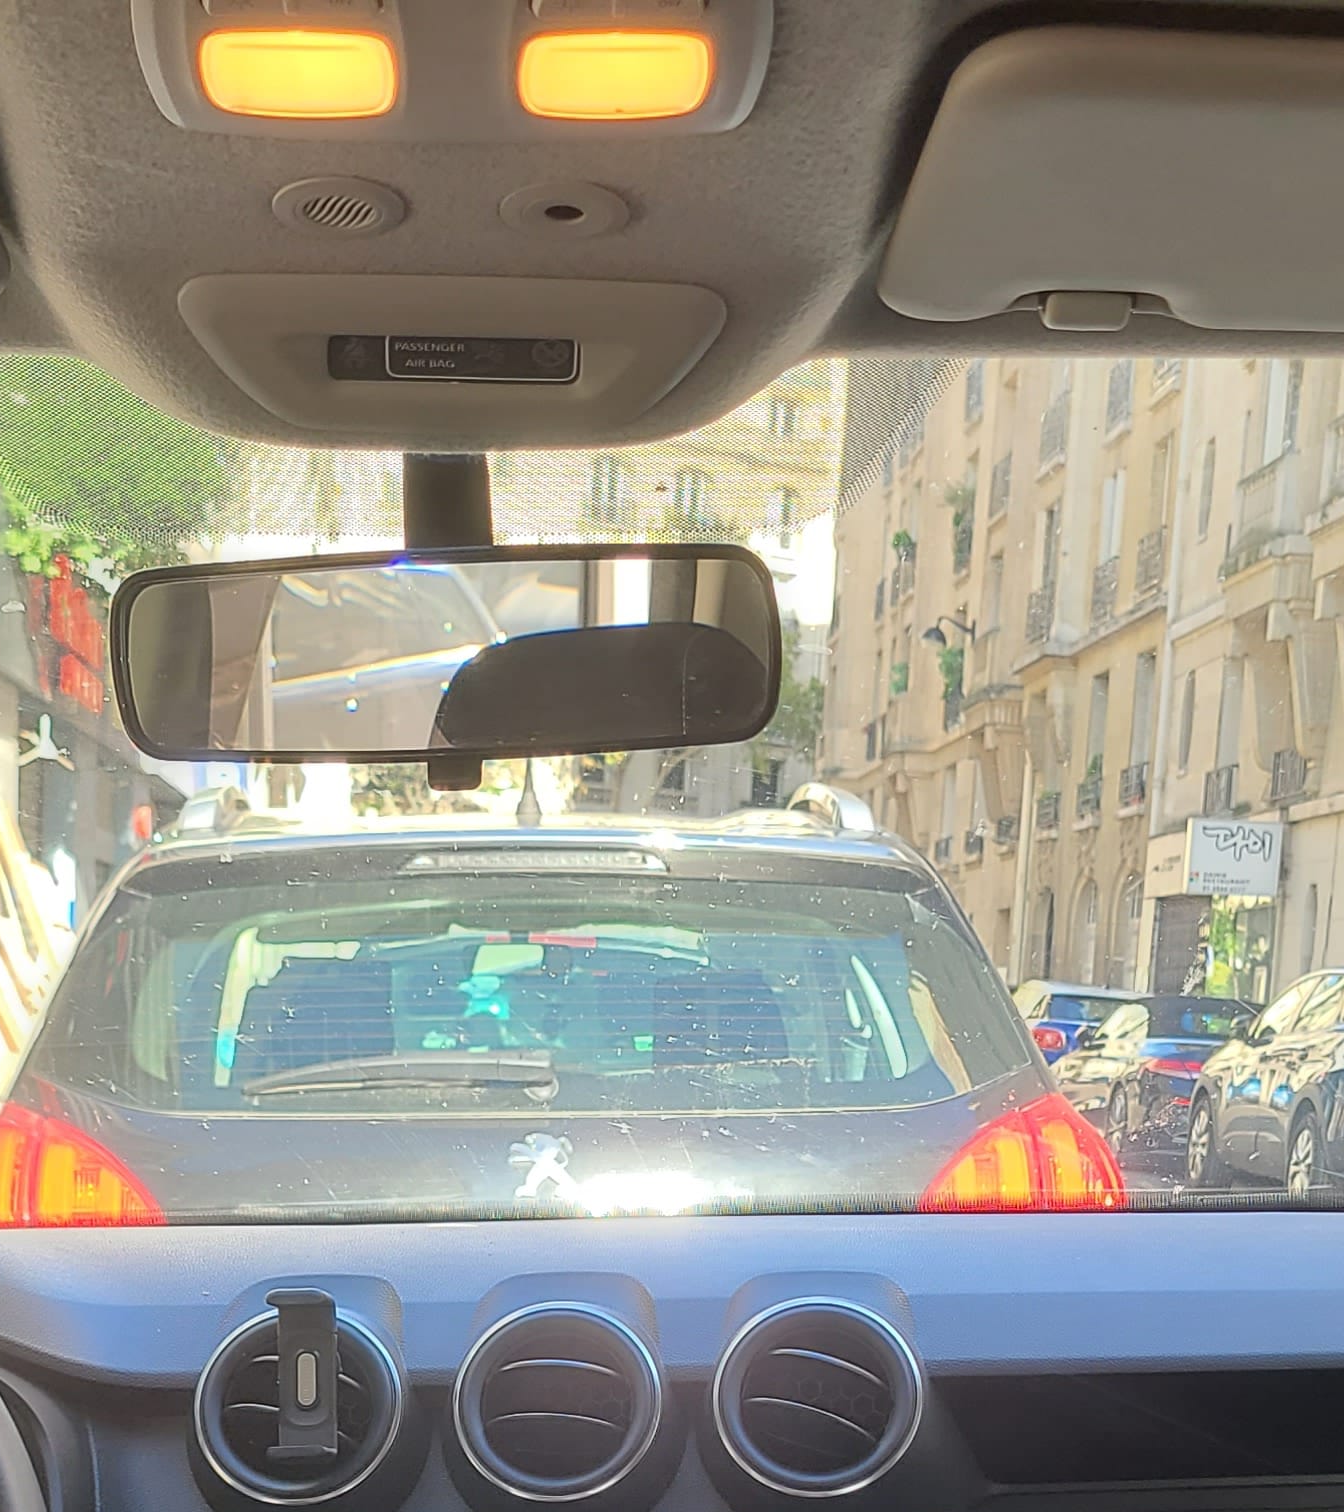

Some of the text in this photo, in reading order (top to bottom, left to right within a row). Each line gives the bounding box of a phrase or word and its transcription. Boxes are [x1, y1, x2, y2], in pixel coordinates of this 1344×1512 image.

[394, 342, 465, 353] PASSENGER
[405, 358, 455, 369] AIR BAG
